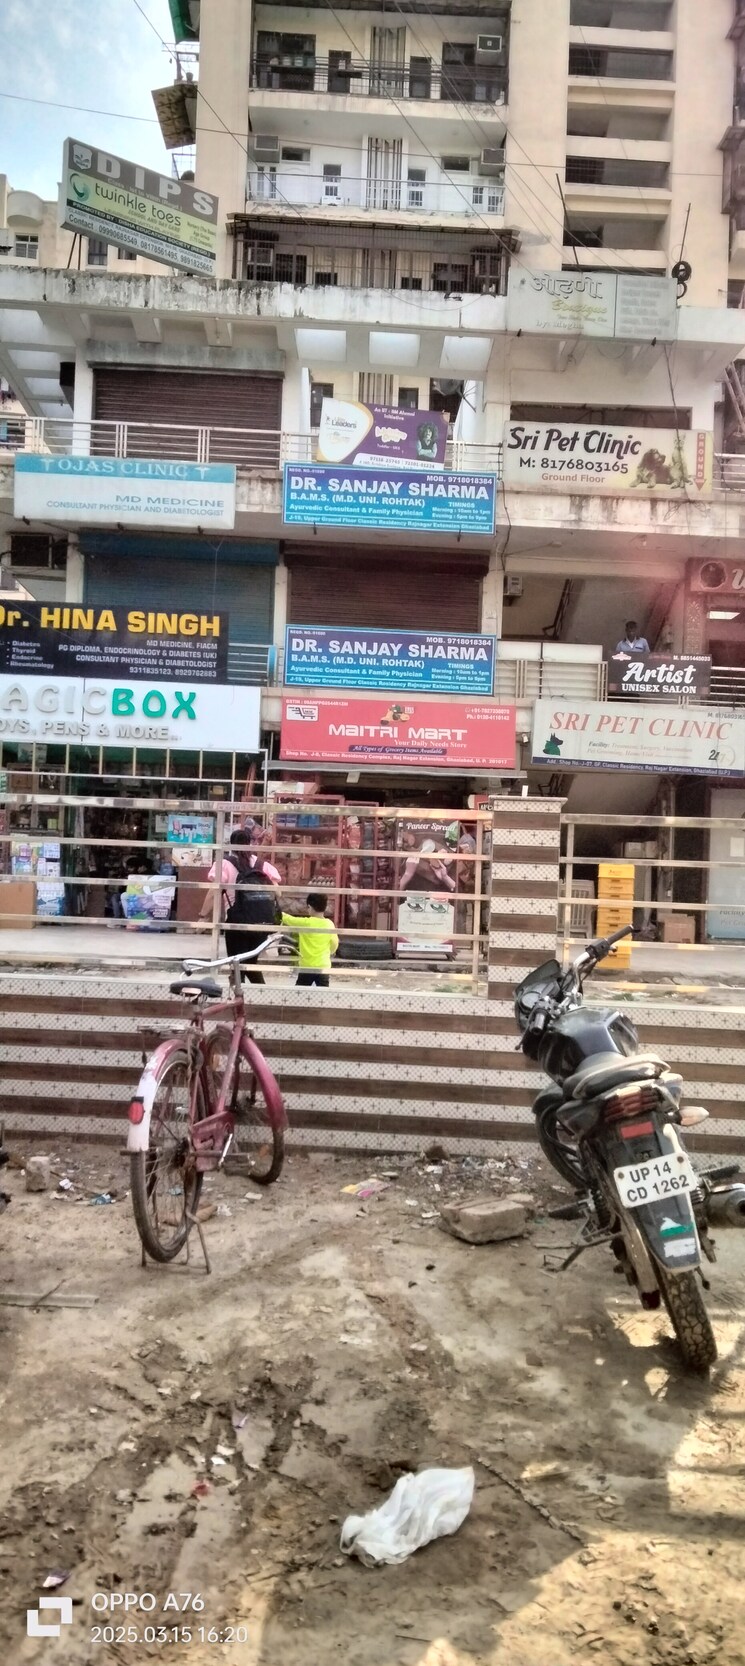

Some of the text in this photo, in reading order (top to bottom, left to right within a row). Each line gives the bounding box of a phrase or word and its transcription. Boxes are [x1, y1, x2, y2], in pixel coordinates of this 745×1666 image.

[97, 152, 213, 216] DIPS
[96, 183, 146, 213] twinkle
[152, 204, 181, 226] toes
[69, 214, 94, 230] Contact
[136, 225, 167, 241] EDUCATION
[168, 236, 191, 248] SOCIETY
[332, 420, 357, 428] Leaders
[508, 427, 642, 460] Sri Pet Clinic
[58, 459, 189, 477] OJAS CLINIC
[520, 457, 629, 474] M: 8176803165
[448, 476, 492, 484] 9718018384
[542, 473, 605, 483] Ground Floor
[290, 476, 489, 500] DR. SANJAY SHARMA
[116, 495, 141, 503] MD
[290, 492, 425, 508] B.A.M.S. (M.D. UNI. ROHTAK)
[46, 501, 97, 509] CONSULTANT
[99, 503, 141, 512] PHYSICIAN
[164, 506, 224, 516] DIABETOLOGIST
[40, 607, 117, 631] HINA
[127, 611, 220, 637] SINGH
[104, 646, 160, 655] ENDOCRINOLOGY
[291, 638, 488, 660] DR. SANJAY SHARMA
[447, 638, 491, 646] 9718018384
[10, 661, 54, 669] Rheumatology
[121, 657, 157, 665] PHYSICIAN
[166, 659, 217, 668] DIABETOLOGIST
[291, 654, 330, 663] B.A.M.S.
[333, 656, 356, 665] (M.D.
[382, 659, 424, 669] ROHTAK)
[622, 662, 696, 683] Artist
[622, 684, 696, 693] UNISEX SALON
[42, 720, 90, 736] PENS
[97, 724, 109, 737] &
[550, 711, 733, 740] SRI PET CLINIC
[630, 1161, 672, 1183] UP 14
[627, 1174, 690, 1202] CD 1262
